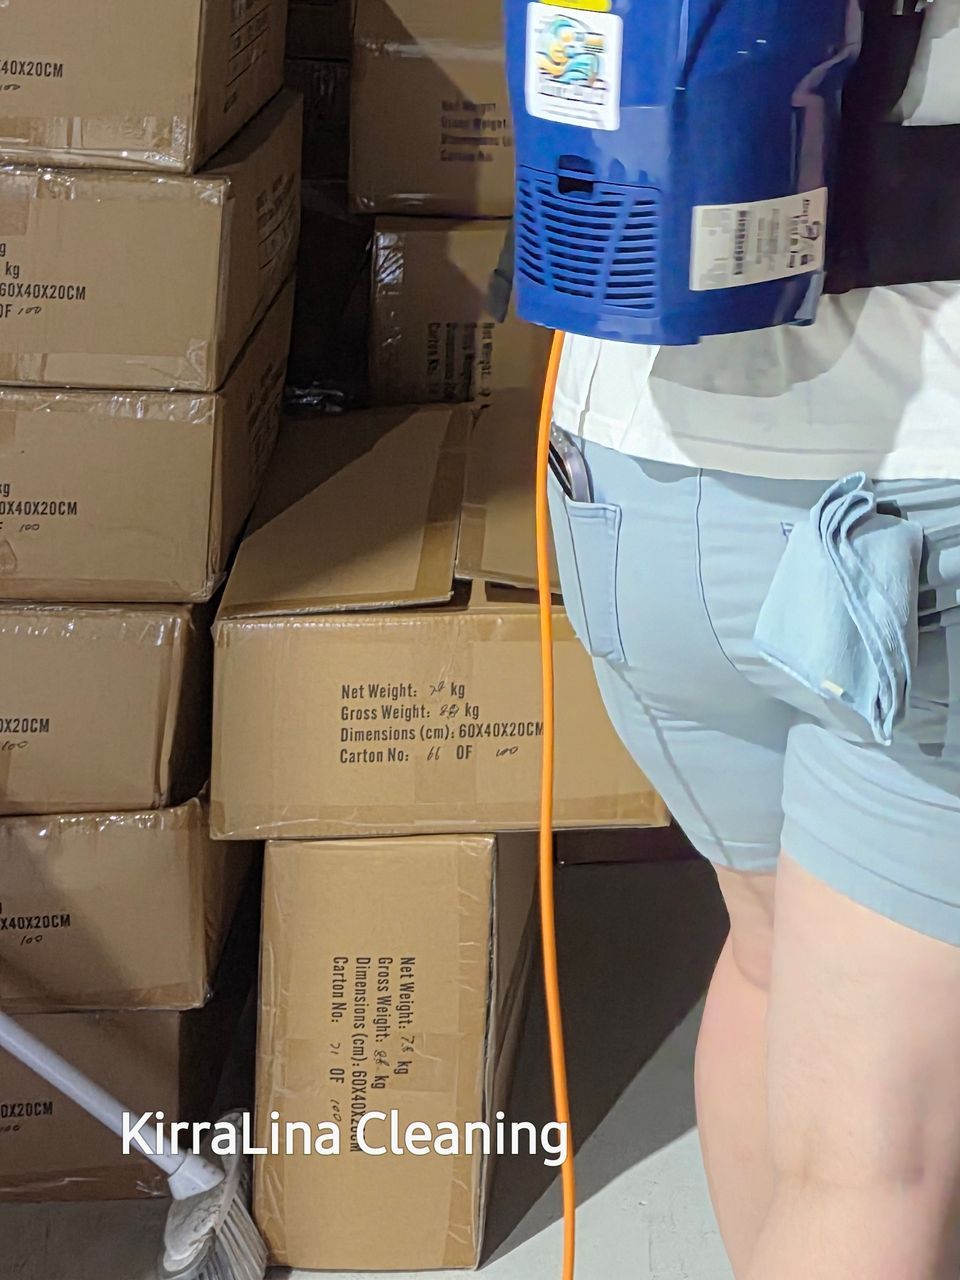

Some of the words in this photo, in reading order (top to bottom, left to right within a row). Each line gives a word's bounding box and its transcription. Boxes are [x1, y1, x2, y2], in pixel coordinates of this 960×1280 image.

[0, 59, 64, 78] 40X20CM
[5, 261, 20, 280] kg
[0, 282, 87, 301] 60X40X20CM
[19, 523, 40, 533] 100
[341, 684, 365, 700] Net
[368, 683, 418, 701] Weight:
[450, 681, 466, 700] kg
[341, 705, 378, 721] Gross
[381, 704, 431, 722] Weight:
[464, 701, 480, 720] kg
[340, 726, 417, 743] Dimensions
[419, 724, 456, 742] (cm):
[458, 721, 545, 739] 60X40X20CM
[1, 740, 29, 752] 100
[340, 747, 384, 764] Carton
[387, 747, 410, 763] No:
[456, 744, 473, 760] OF
[20, 934, 43, 947] 100
[331, 956, 349, 999] Carton
[376, 956, 394, 993] Gross
[400, 956, 416, 979] Net
[352, 956, 371, 1030] Dimensions
[330, 1002, 348, 1023] No:
[395, 981, 416, 1030] Weight:
[372, 994, 393, 1043] Weight:
[350, 1033, 369, 1067] (cm):
[329, 1068, 346, 1084] OF
[393, 1060, 413, 1075] kg
[370, 1074, 390, 1090] kg
[330, 1099, 342, 1122] 100
